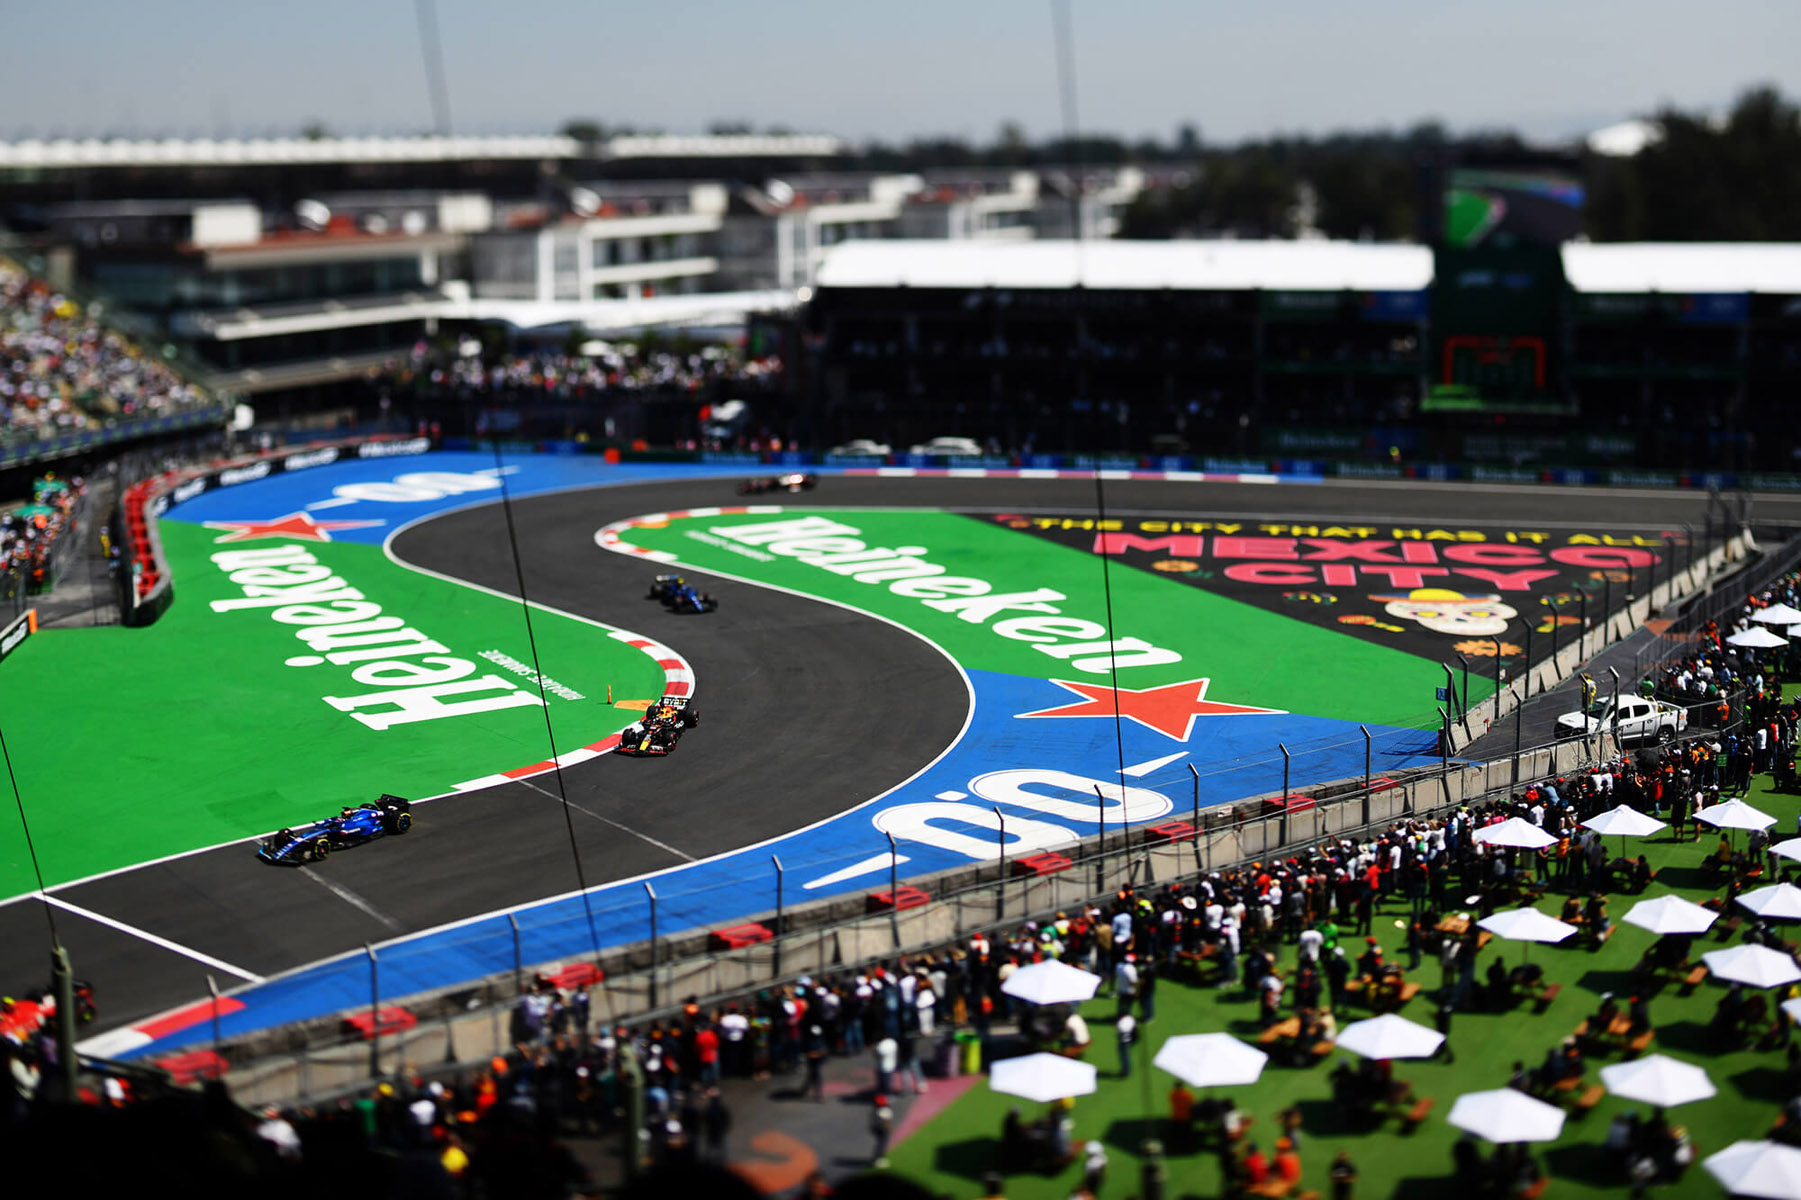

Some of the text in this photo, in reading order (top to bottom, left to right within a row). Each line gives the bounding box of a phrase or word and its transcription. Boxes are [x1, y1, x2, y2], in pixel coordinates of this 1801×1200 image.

[1033, 518, 1665, 546] THE CITY THAT HAS IT ALL
[1093, 532, 1661, 568] MEXICO
[708, 516, 1183, 674] Heineken
[1223, 563, 1560, 591] CITY
[209, 544, 550, 731] Heineken
